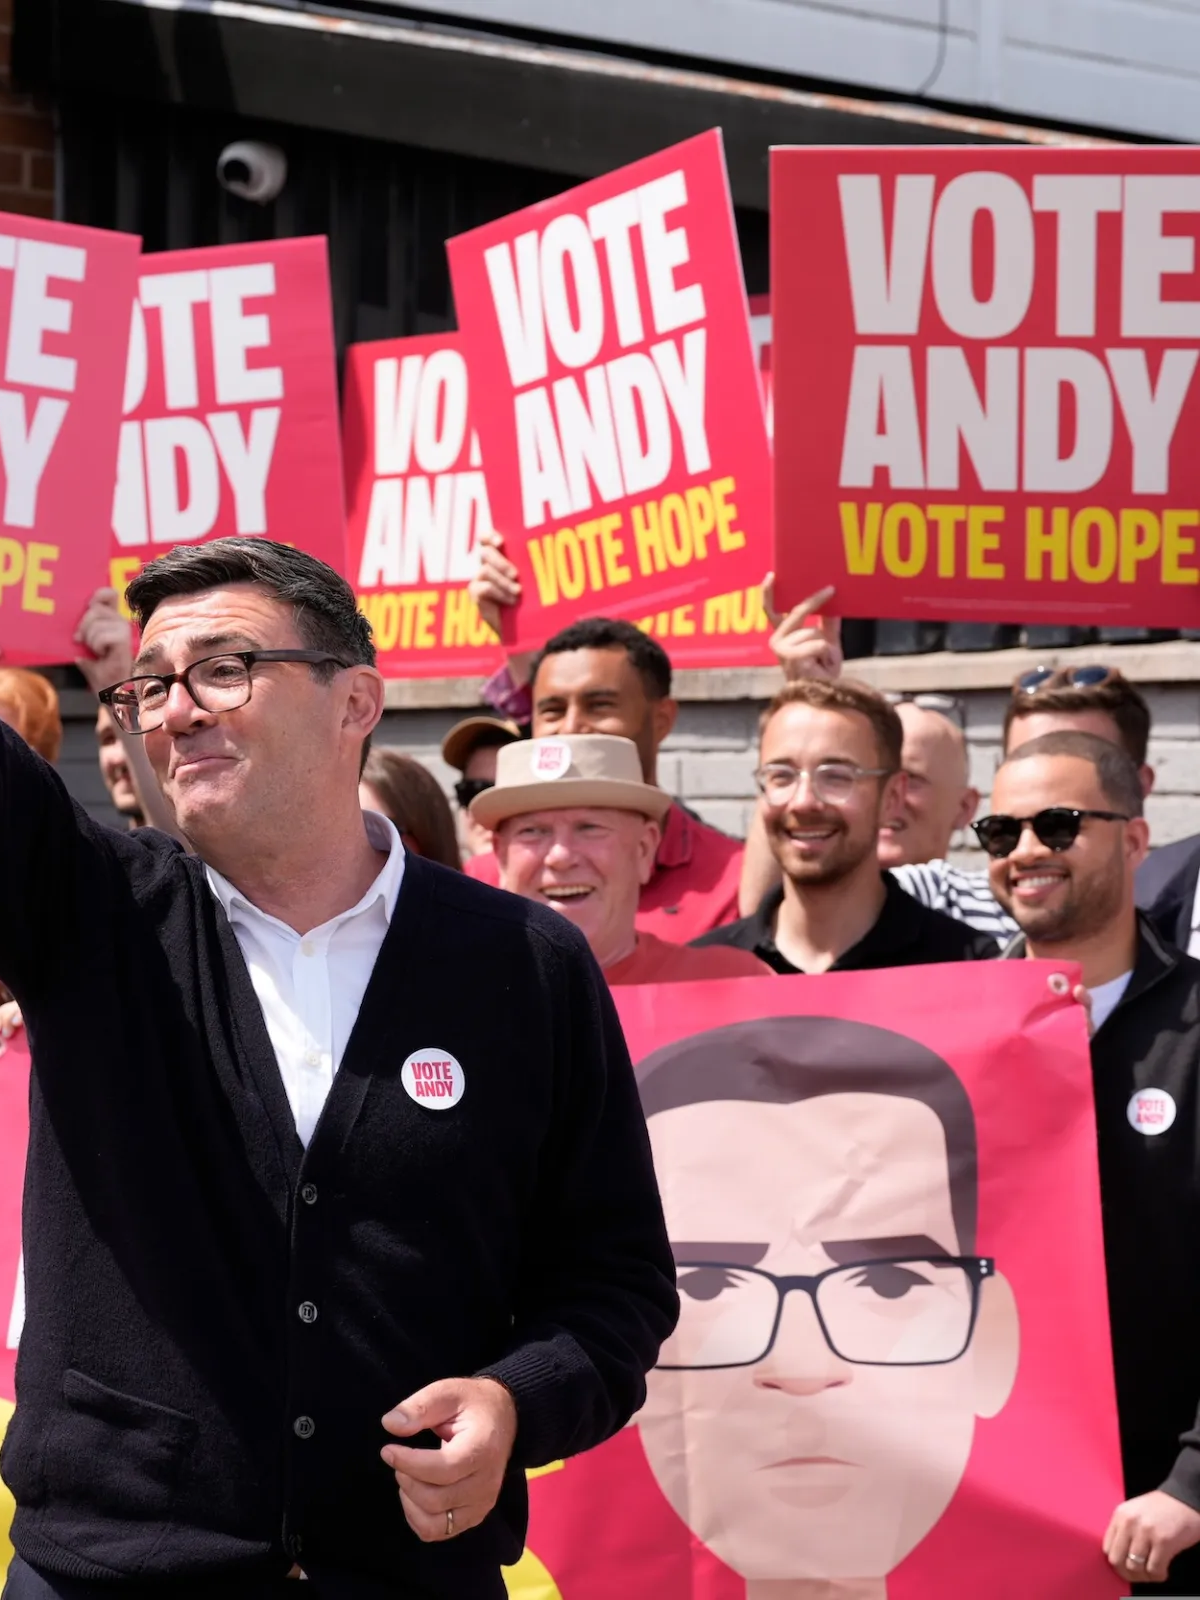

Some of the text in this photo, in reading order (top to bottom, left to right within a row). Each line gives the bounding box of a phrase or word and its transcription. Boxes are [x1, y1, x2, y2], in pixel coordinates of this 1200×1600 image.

[484, 169, 707, 388] VOTE
[837, 171, 1200, 340] VOTE
[122, 262, 284, 415] TE
[374, 348, 483, 475] VO
[513, 327, 711, 530] ANDY
[838, 345, 1200, 494] ANDY
[358, 470, 494, 587] AND
[527, 512, 631, 607] VOTE
[631, 476, 746, 578] HOPE
[838, 502, 1200, 585] VOTE HOPE
[411, 1061, 453, 1080] VOTE
[415, 1081, 453, 1097] ANDY
